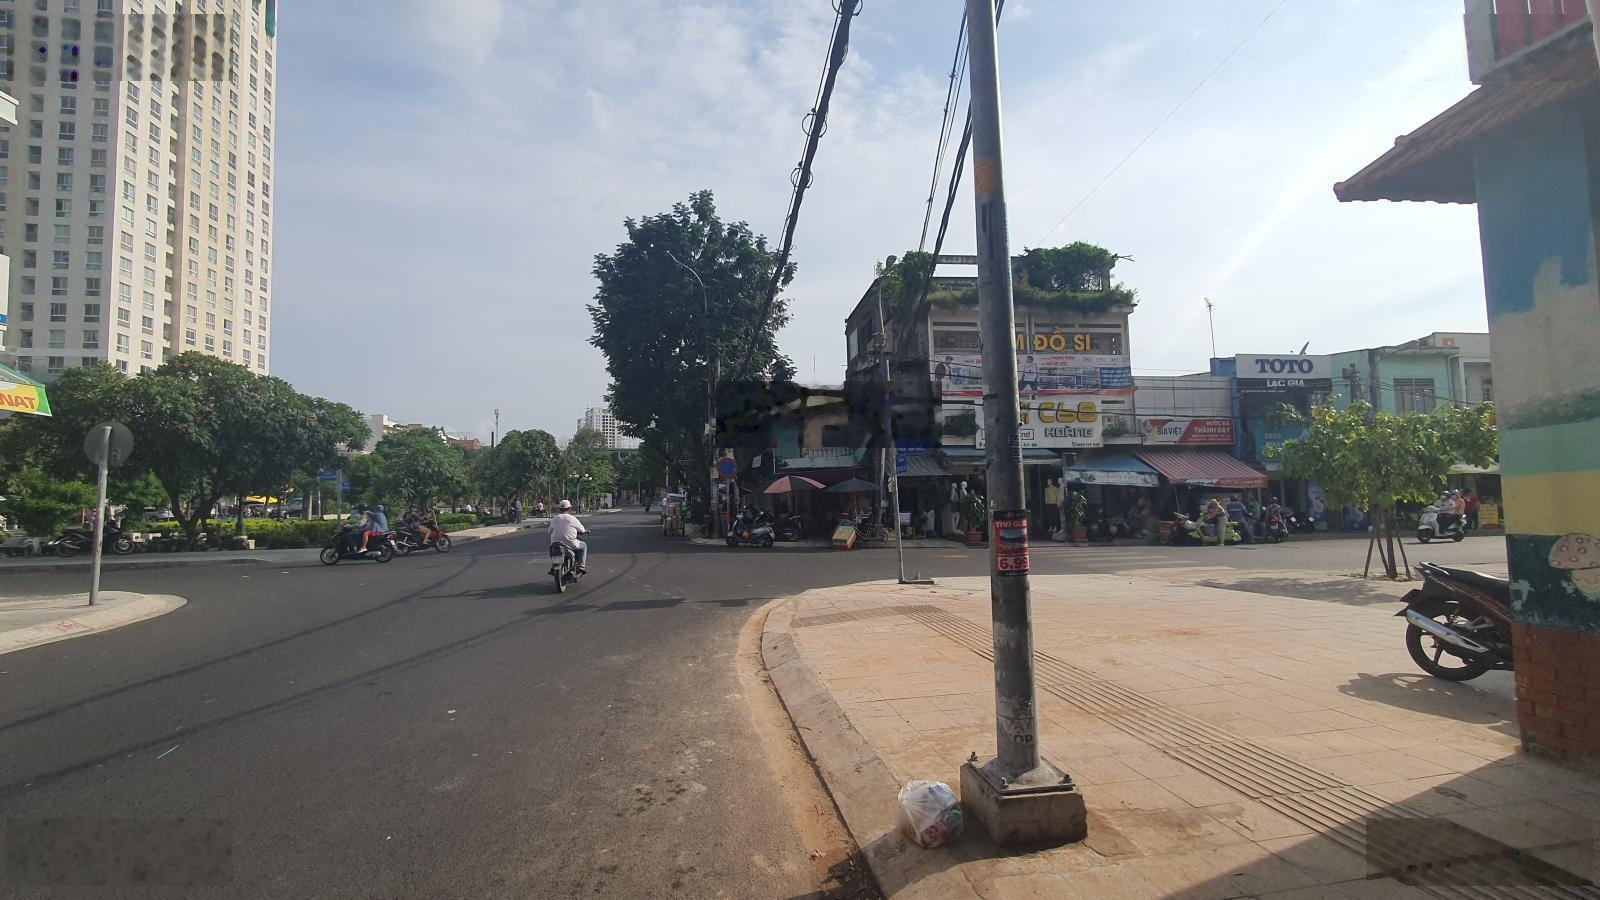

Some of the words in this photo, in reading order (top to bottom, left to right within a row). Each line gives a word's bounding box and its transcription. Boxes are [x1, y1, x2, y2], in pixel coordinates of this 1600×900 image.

[1033, 326, 1066, 351] ĐỒ
[1073, 334, 1091, 351] SI
[1256, 358, 1313, 374] TOTO
